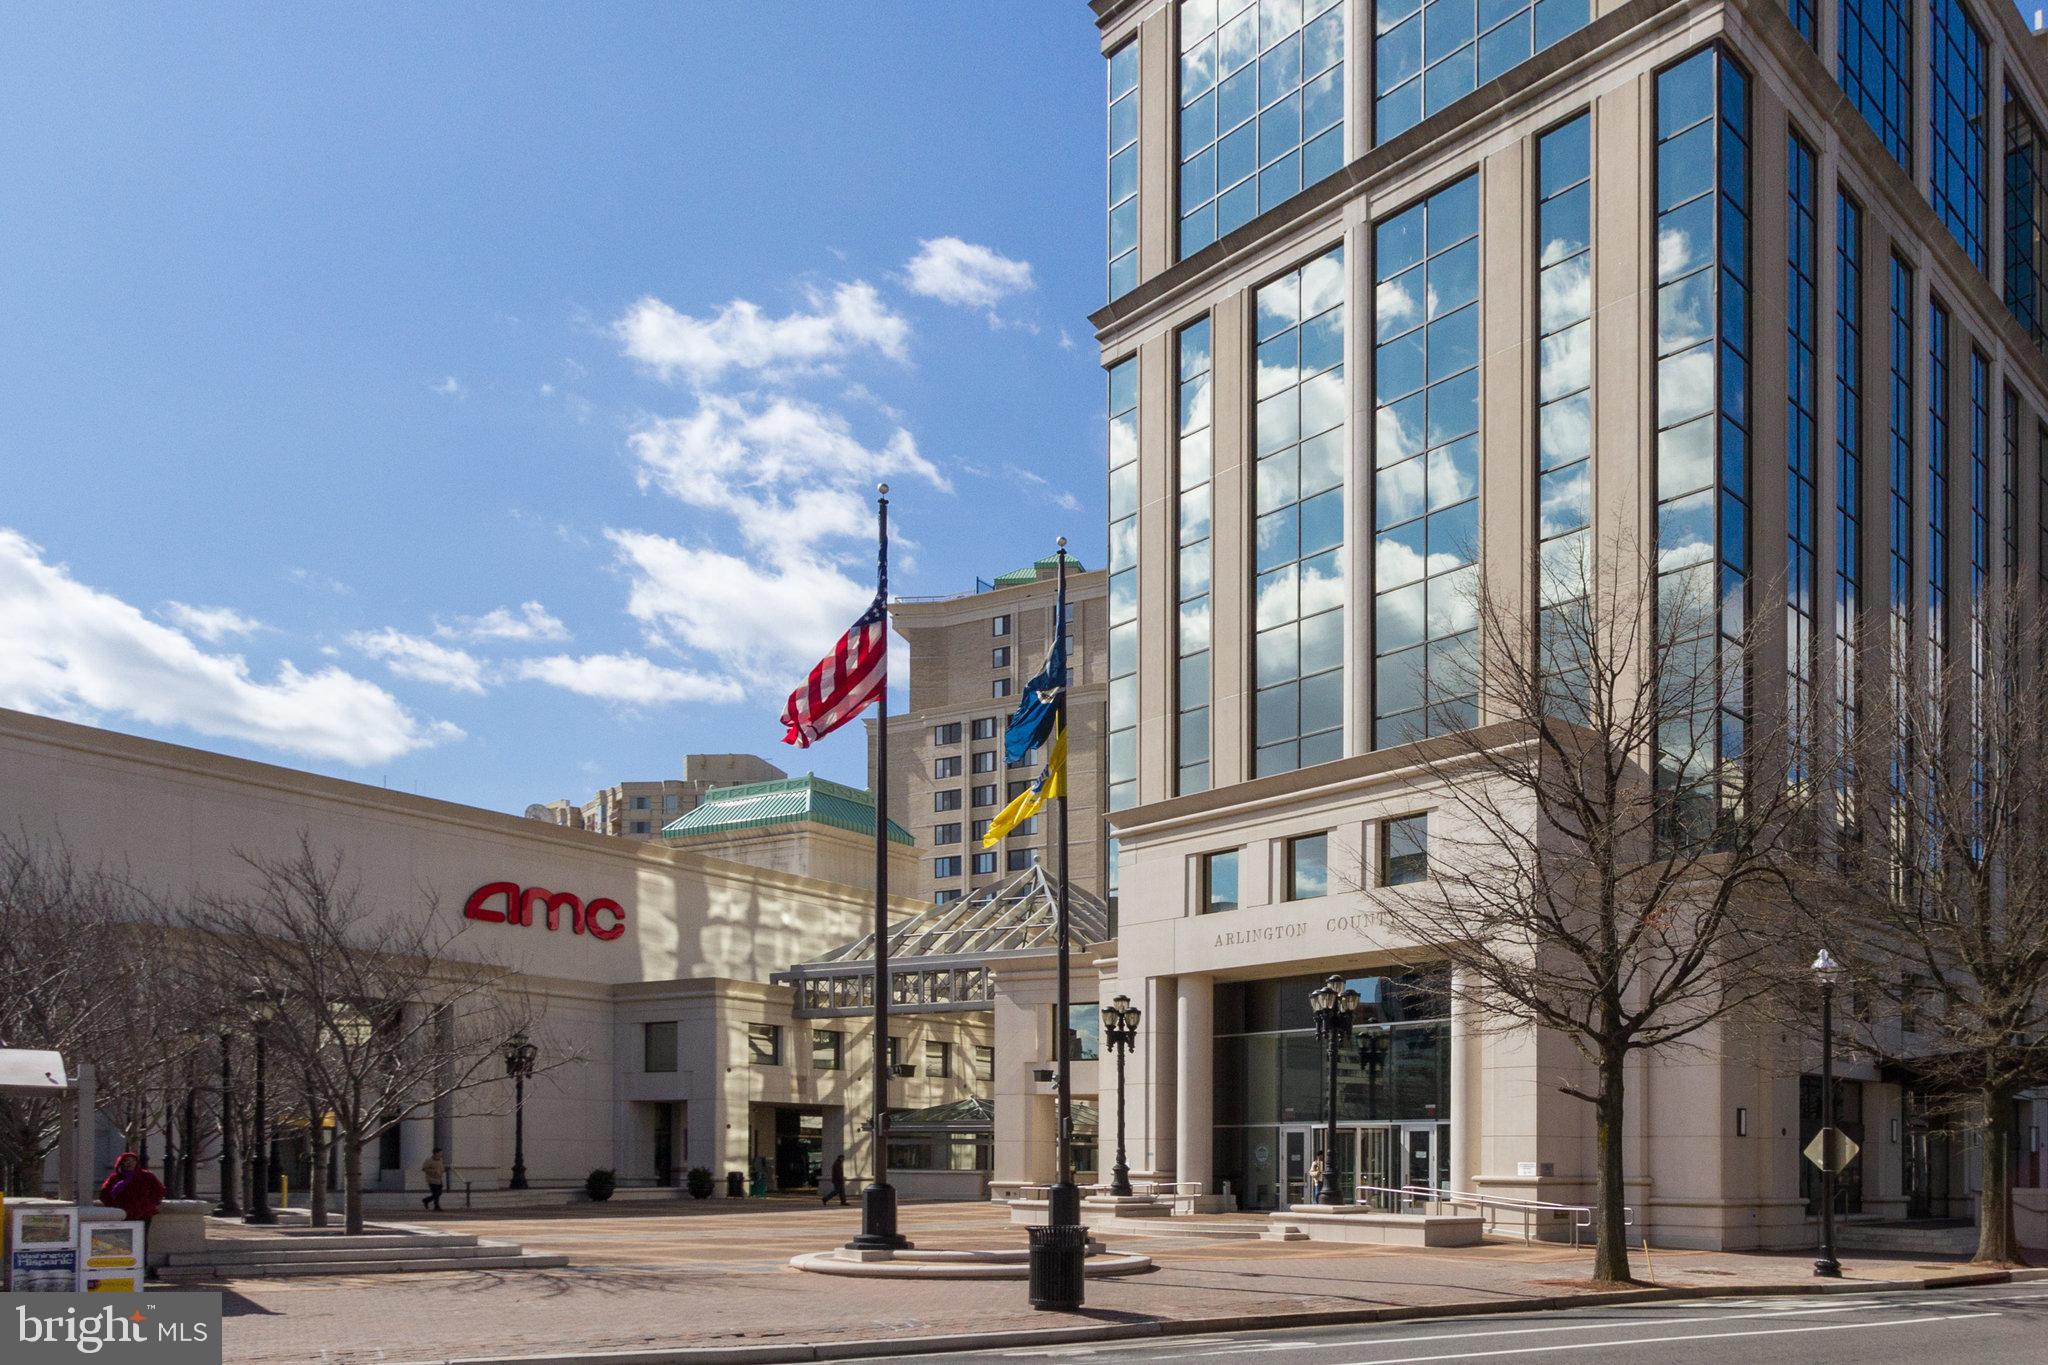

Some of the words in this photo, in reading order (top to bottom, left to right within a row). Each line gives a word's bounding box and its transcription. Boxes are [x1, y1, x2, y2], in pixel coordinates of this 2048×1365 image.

[464, 882, 626, 941] amc
[1214, 922, 1307, 947] ARLINGTON
[18, 1258, 73, 1266] Hispanic
